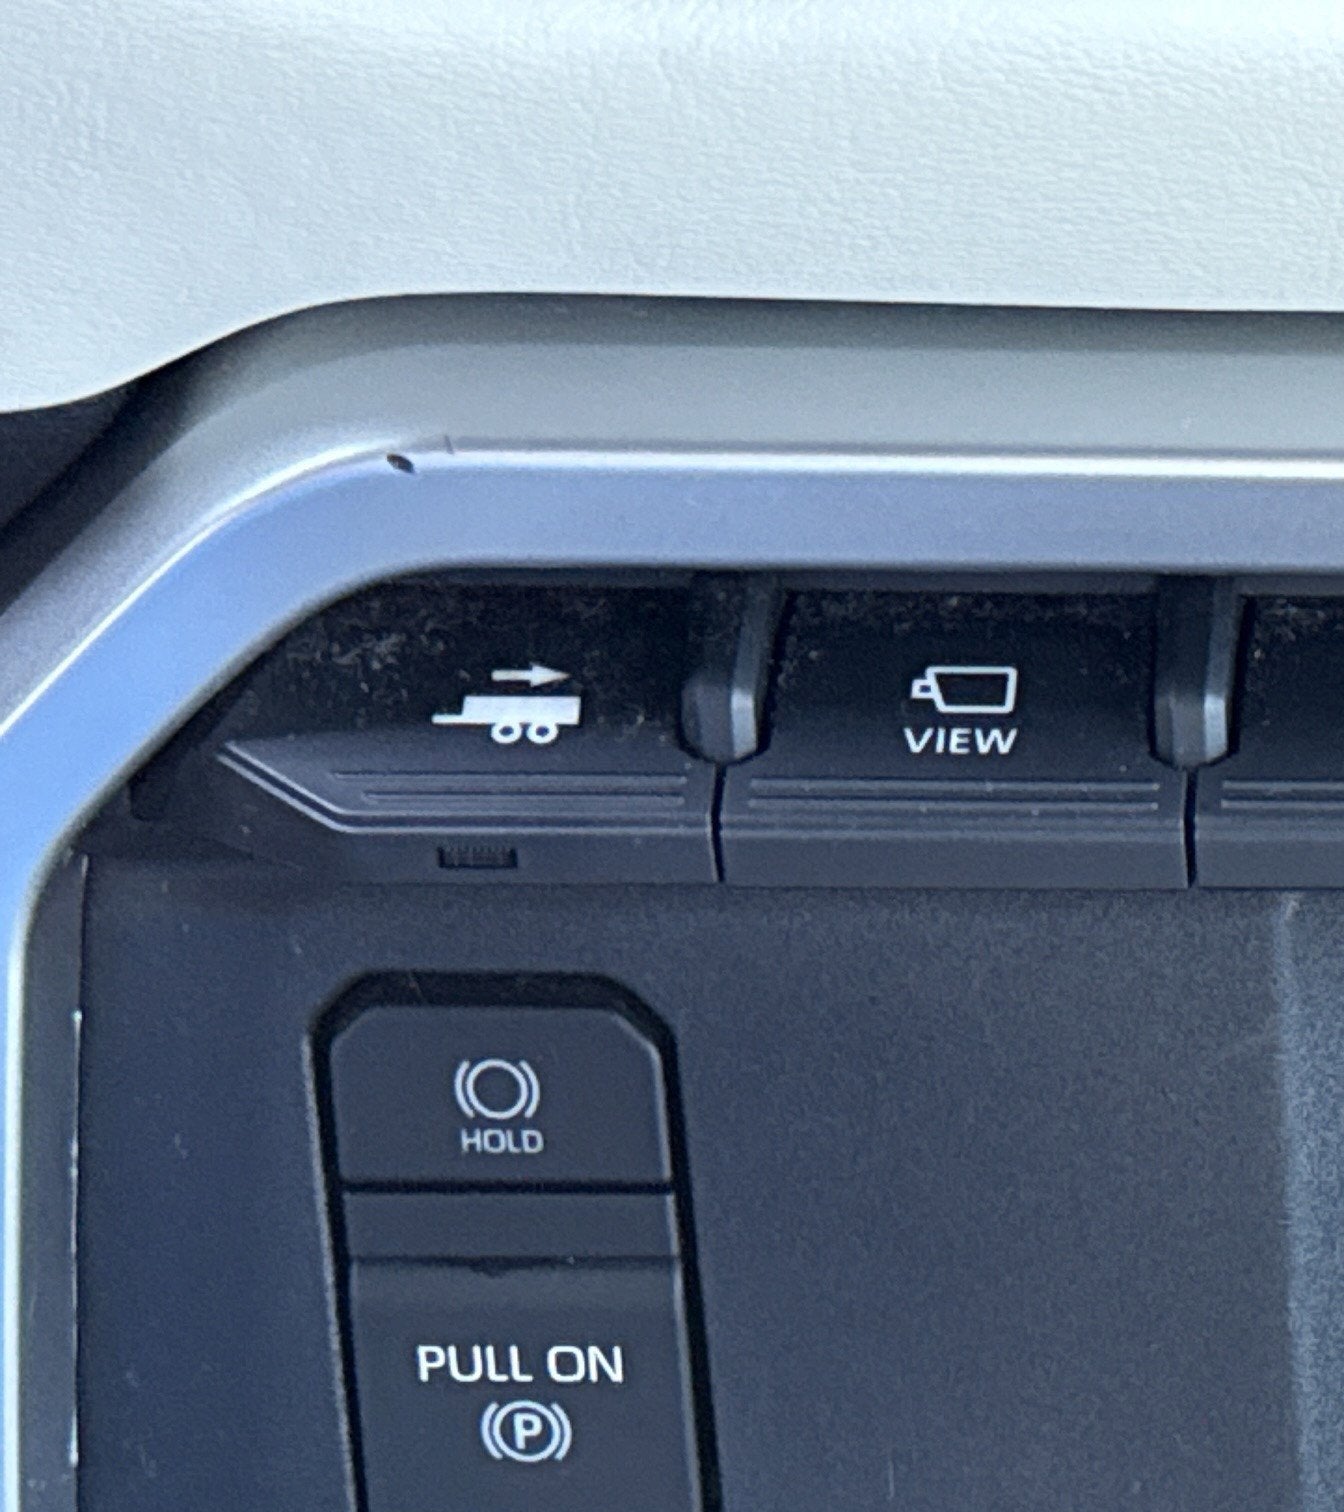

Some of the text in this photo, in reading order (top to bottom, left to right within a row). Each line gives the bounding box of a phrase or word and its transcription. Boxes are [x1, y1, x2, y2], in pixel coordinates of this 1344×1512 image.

[902, 727, 1019, 756] VIEW
[460, 1128, 545, 1154] HOLD
[416, 1344, 624, 1384] PULL ON
